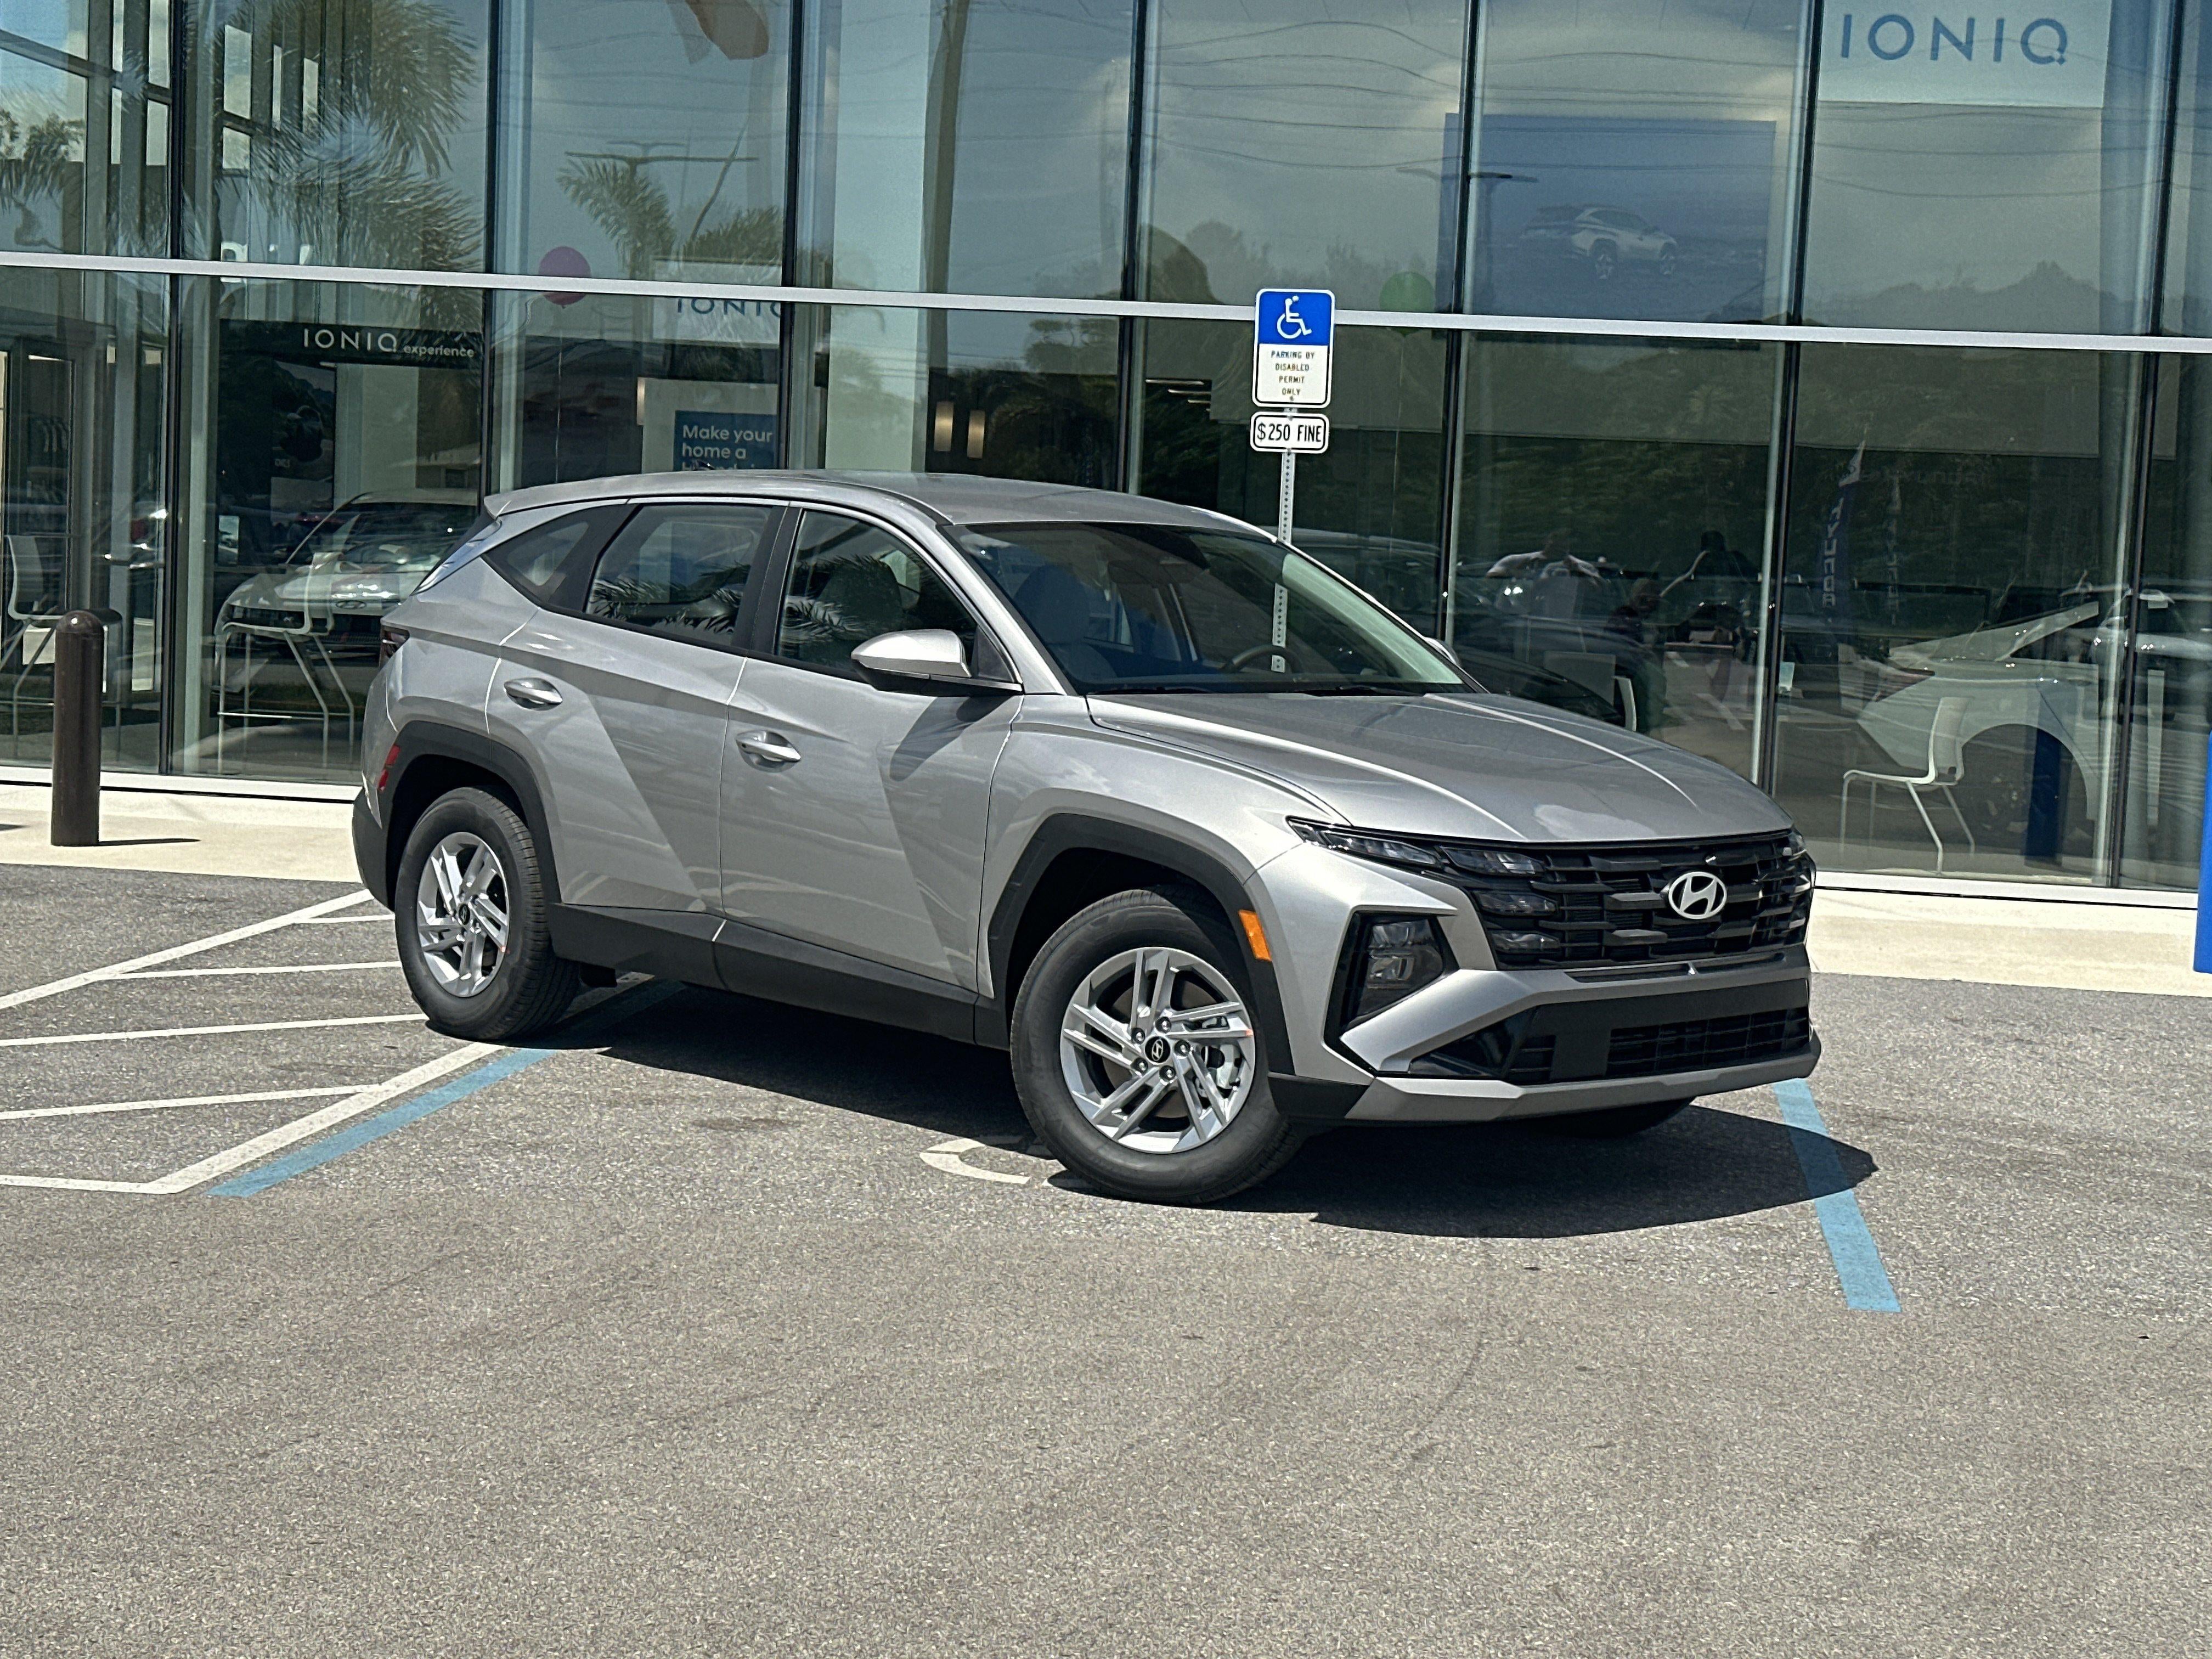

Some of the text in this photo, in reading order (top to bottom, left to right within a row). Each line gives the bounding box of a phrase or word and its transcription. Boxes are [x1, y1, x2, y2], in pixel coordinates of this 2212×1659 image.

[1840, 13, 2068, 66] IONIQ
[303, 328, 475, 358] IONIQ experience
[1271, 350, 1302, 359] PARKING
[1275, 363, 1310, 371] DISABLED
[682, 425, 773, 443] Make your
[1257, 422, 1322, 443] $250 FINE
[682, 442, 747, 459] home a
